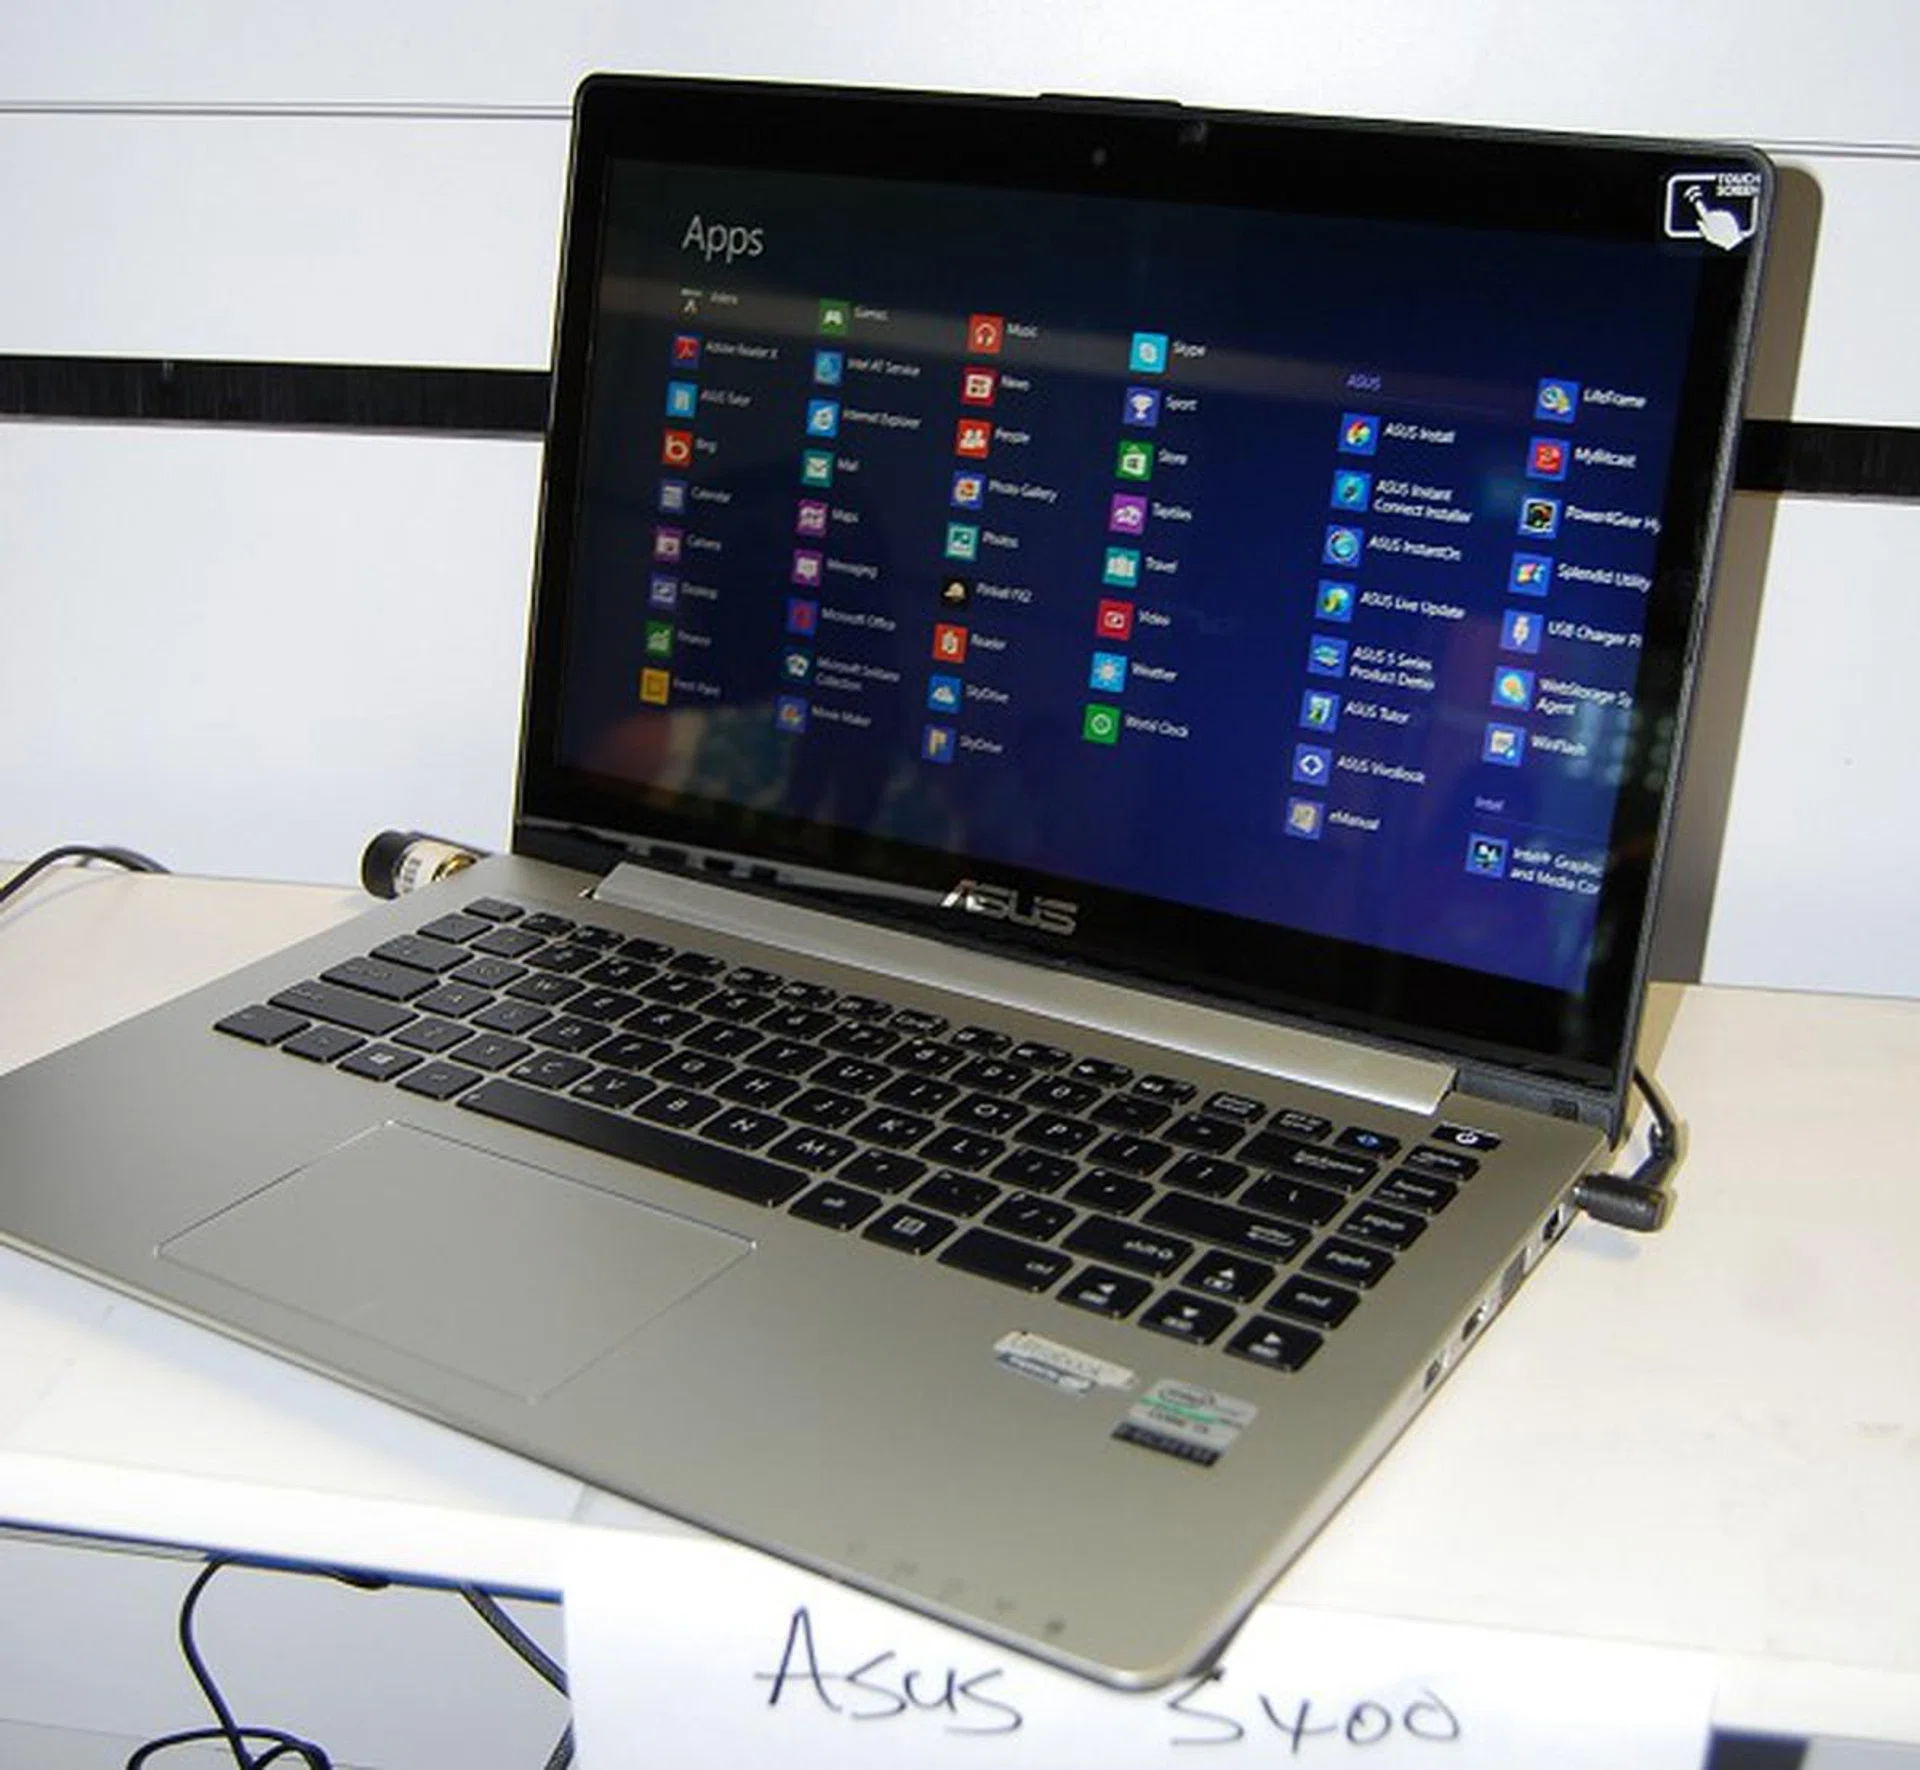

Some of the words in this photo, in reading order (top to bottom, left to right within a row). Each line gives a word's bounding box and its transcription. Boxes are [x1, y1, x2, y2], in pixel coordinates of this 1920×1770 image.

[681, 214, 764, 263] Apps
[1007, 322, 1038, 338] Music
[1172, 340, 1206, 358] Skype
[885, 360, 921, 377] Service
[1001, 376, 1030, 391] News
[1347, 374, 1381, 391] ASUS
[843, 409, 879, 424] Internet
[879, 412, 922, 430] Explorer
[994, 428, 1030, 445] People
[1384, 422, 1418, 440] ASUS
[1419, 427, 1456, 444] Install
[837, 458, 859, 472] Mail
[1158, 449, 1188, 465] Store
[691, 486, 732, 503] Calendar
[990, 480, 1019, 497] Photo
[1020, 484, 1061, 504] Gallery
[1375, 480, 1409, 498] ASUS
[1411, 485, 1453, 502] Instant
[1372, 498, 1424, 516] Connect
[1425, 506, 1474, 524] Installer
[982, 531, 1019, 549] Photos
[1367, 535, 1402, 552] ASUS
[827, 558, 878, 580] Messaging
[1145, 556, 1178, 574] Travel
[1557, 563, 1614, 585] Splendid
[1614, 573, 1653, 594] Utility
[1359, 592, 1393, 609] ASUS
[1394, 598, 1418, 612] Live
[1420, 602, 1466, 620] Update
[822, 608, 865, 625] Microsoft
[866, 614, 896, 631] Office
[1138, 610, 1171, 628] Video
[970, 633, 1006, 651] Reader
[1548, 620, 1575, 638] USB
[1576, 625, 1627, 648] Charger
[1352, 646, 1385, 664] ASUS
[1397, 653, 1433, 672] Series
[1131, 661, 1178, 682] Weather
[1350, 665, 1396, 683] Product
[965, 684, 1010, 704] SkyDrive
[1344, 701, 1378, 718] ASUS
[1536, 697, 1576, 716] Agent
[1125, 713, 1157, 732] World
[1157, 719, 1189, 738] Clock
[1337, 755, 1370, 773] ASUS
[1510, 868, 1534, 882] and
[1536, 871, 1576, 891] Media
[940, 878, 1080, 936] ASUS
[754, 1606, 1023, 1735] Asus
